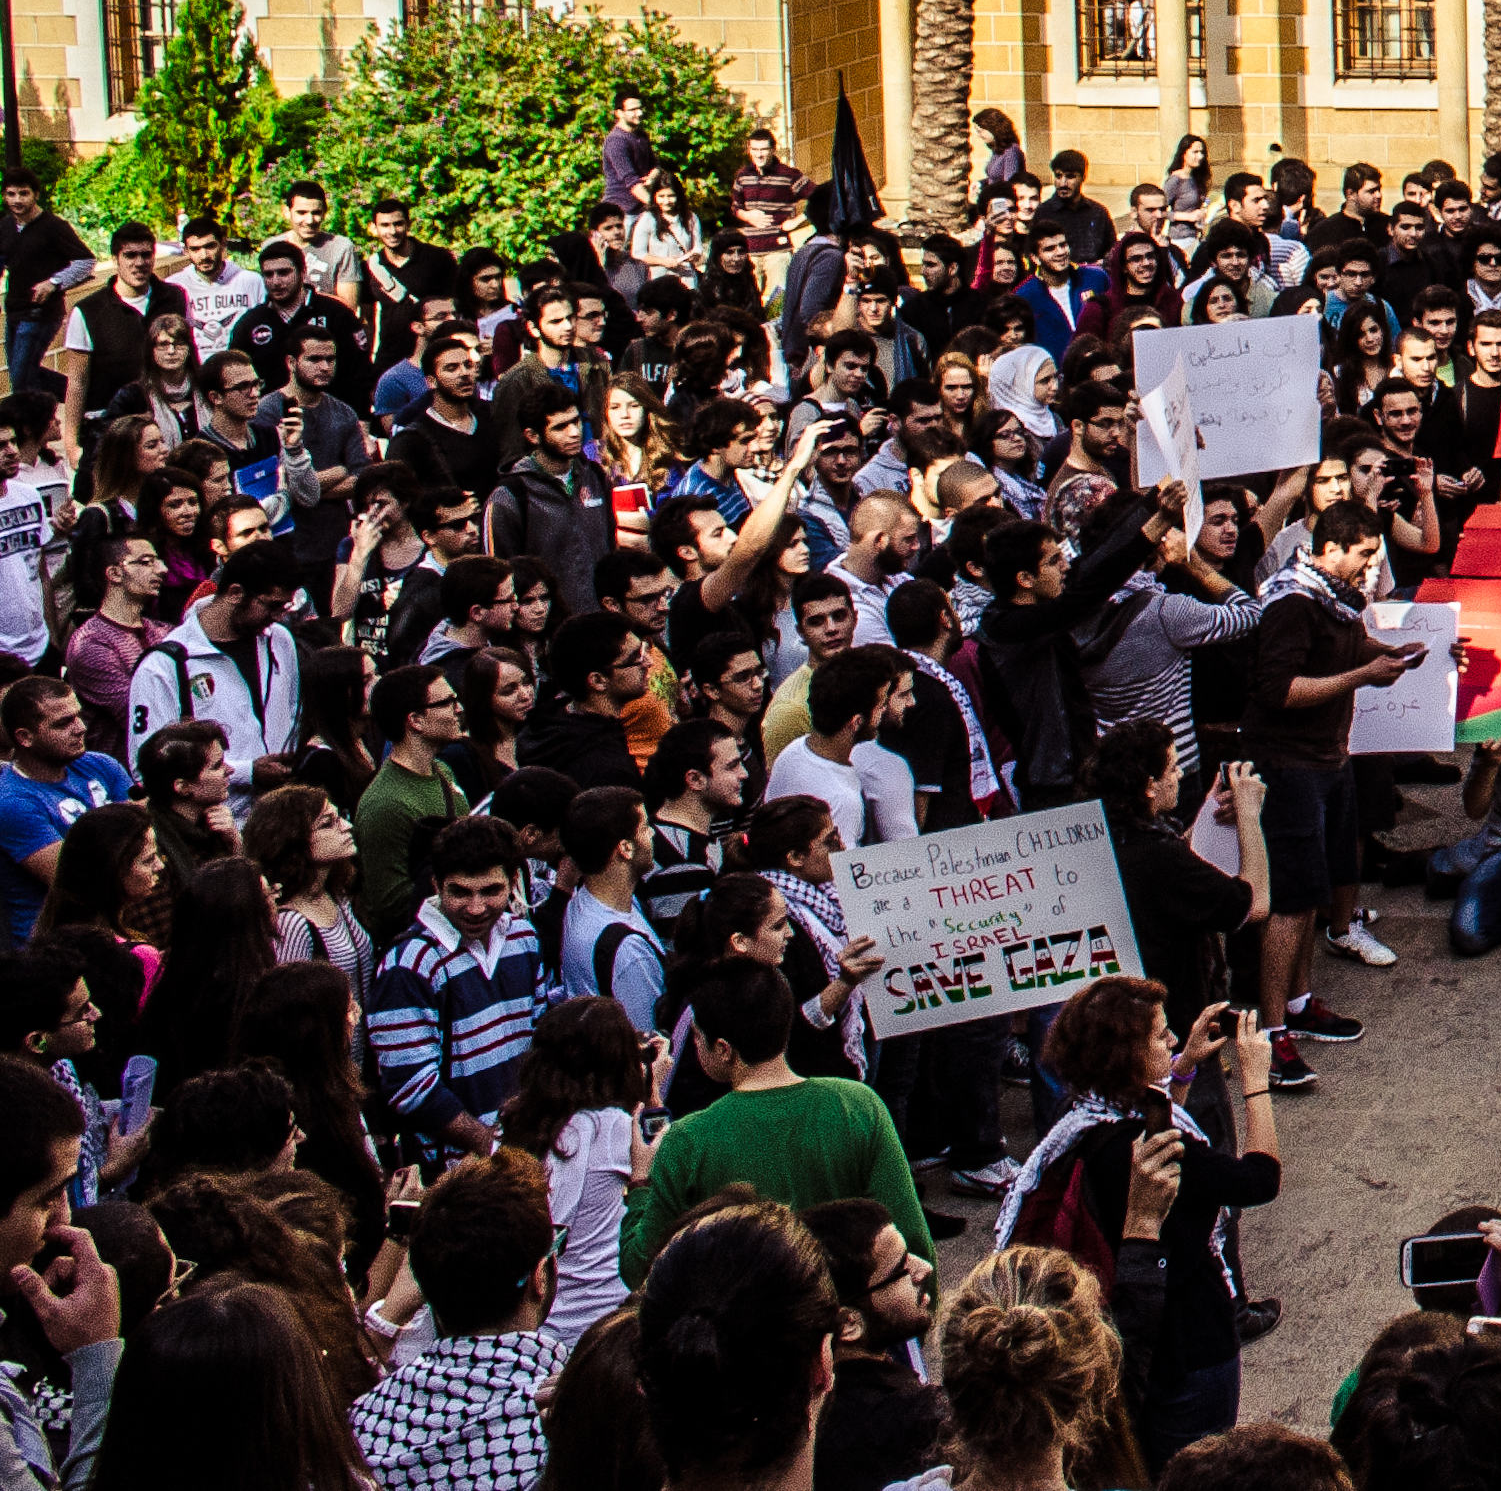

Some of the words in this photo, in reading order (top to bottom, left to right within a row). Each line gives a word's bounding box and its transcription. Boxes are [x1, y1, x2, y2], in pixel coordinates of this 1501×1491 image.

[190, 296, 210, 311] AST
[215, 294, 249, 308] GUARD
[133, 705, 148, 734] 3
[850, 861, 925, 890] Because
[926, 842, 1012, 878] Palestinian
[1015, 822, 1105, 859] CHILDREN
[872, 898, 892, 916] are
[929, 867, 1037, 909] THREAT
[1054, 863, 1079, 887] to
[886, 925, 923, 949] the
[1051, 896, 1067, 916] of
[930, 926, 1033, 960] ISRAEL
[883, 952, 993, 1016] SAVE
[1001, 924, 1122, 993] GAZA
